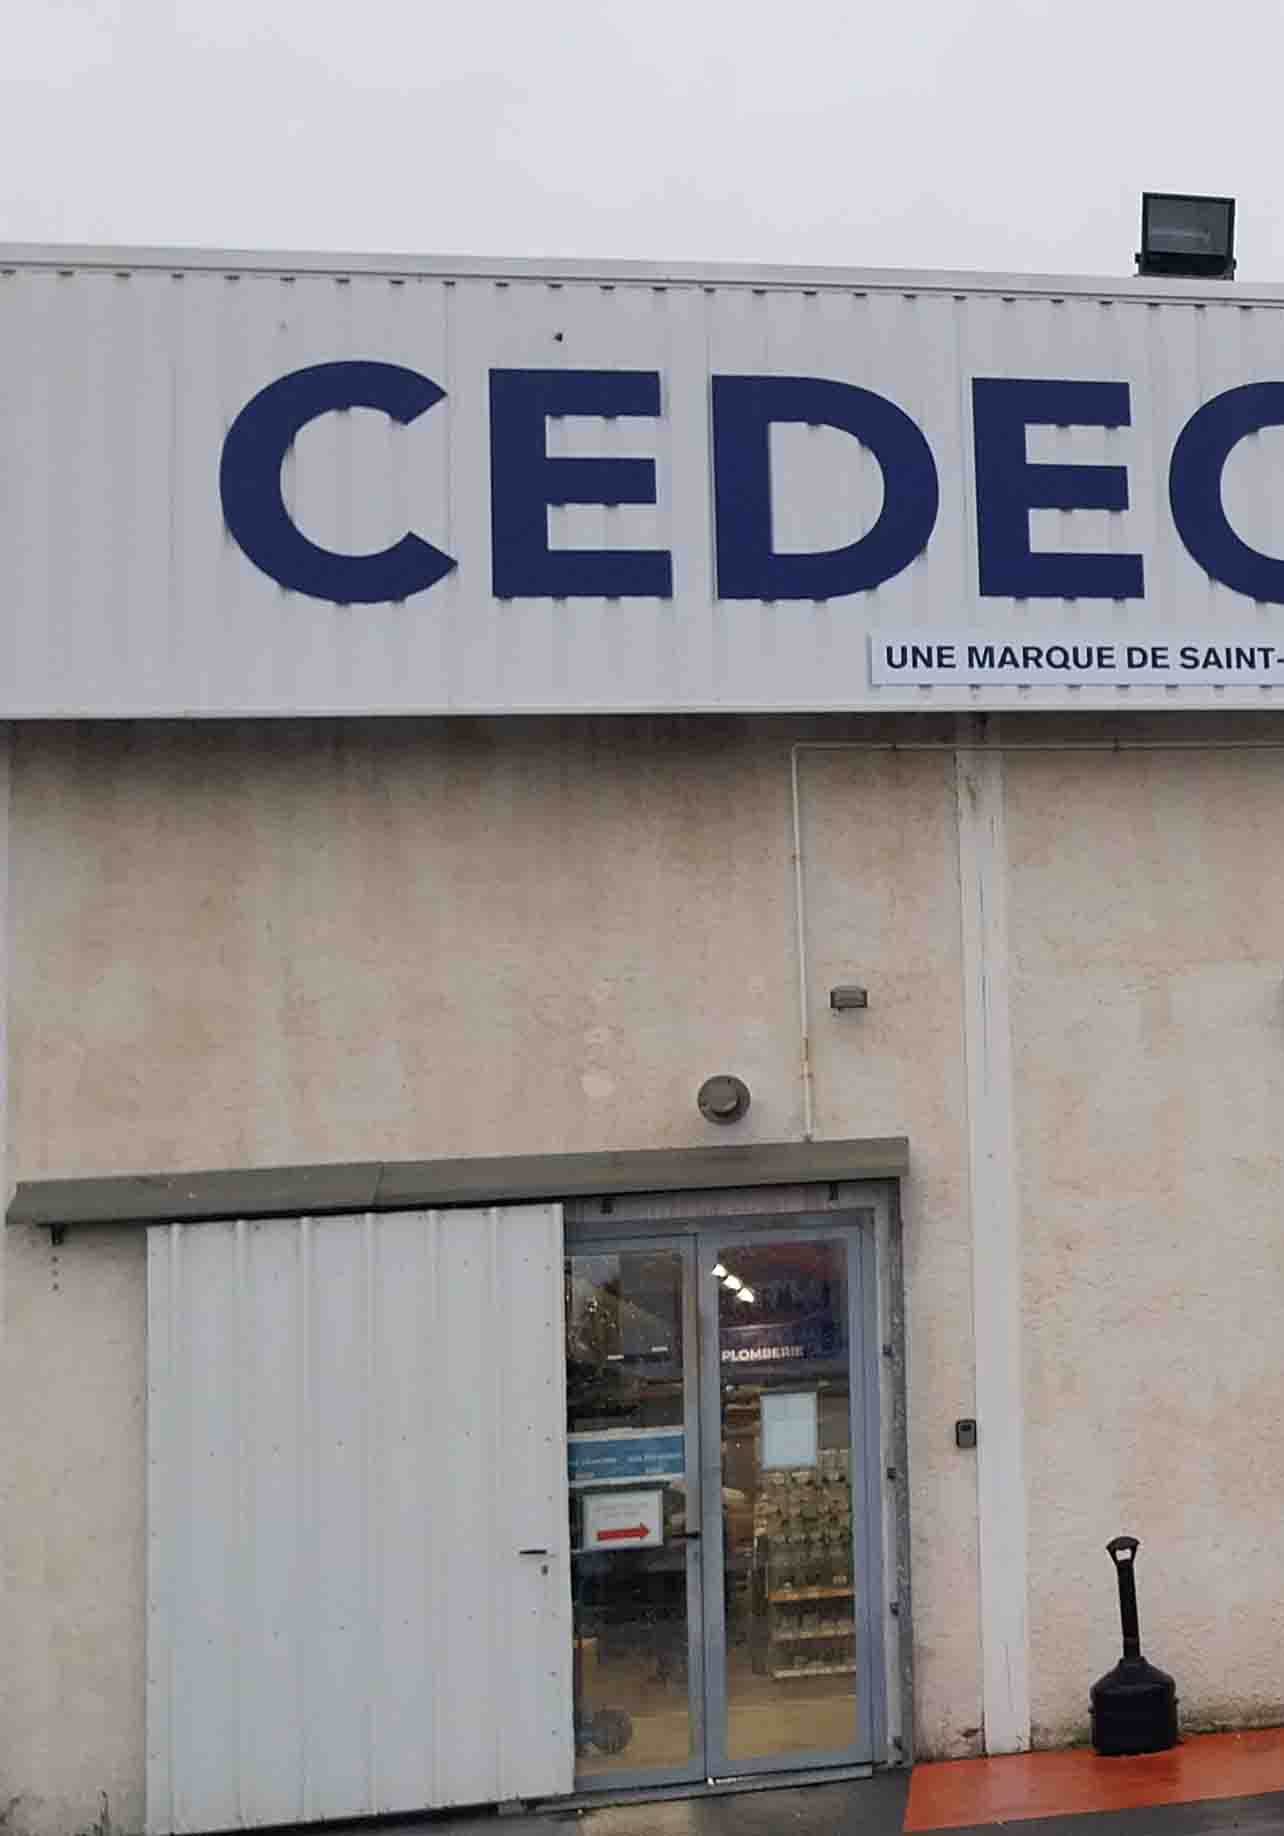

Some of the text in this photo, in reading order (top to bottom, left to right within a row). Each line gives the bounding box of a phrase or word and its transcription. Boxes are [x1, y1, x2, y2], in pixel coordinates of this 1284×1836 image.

[885, 645, 956, 669] UNE
[967, 645, 1117, 671] MARQUE
[1126, 646, 1170, 669] DE
